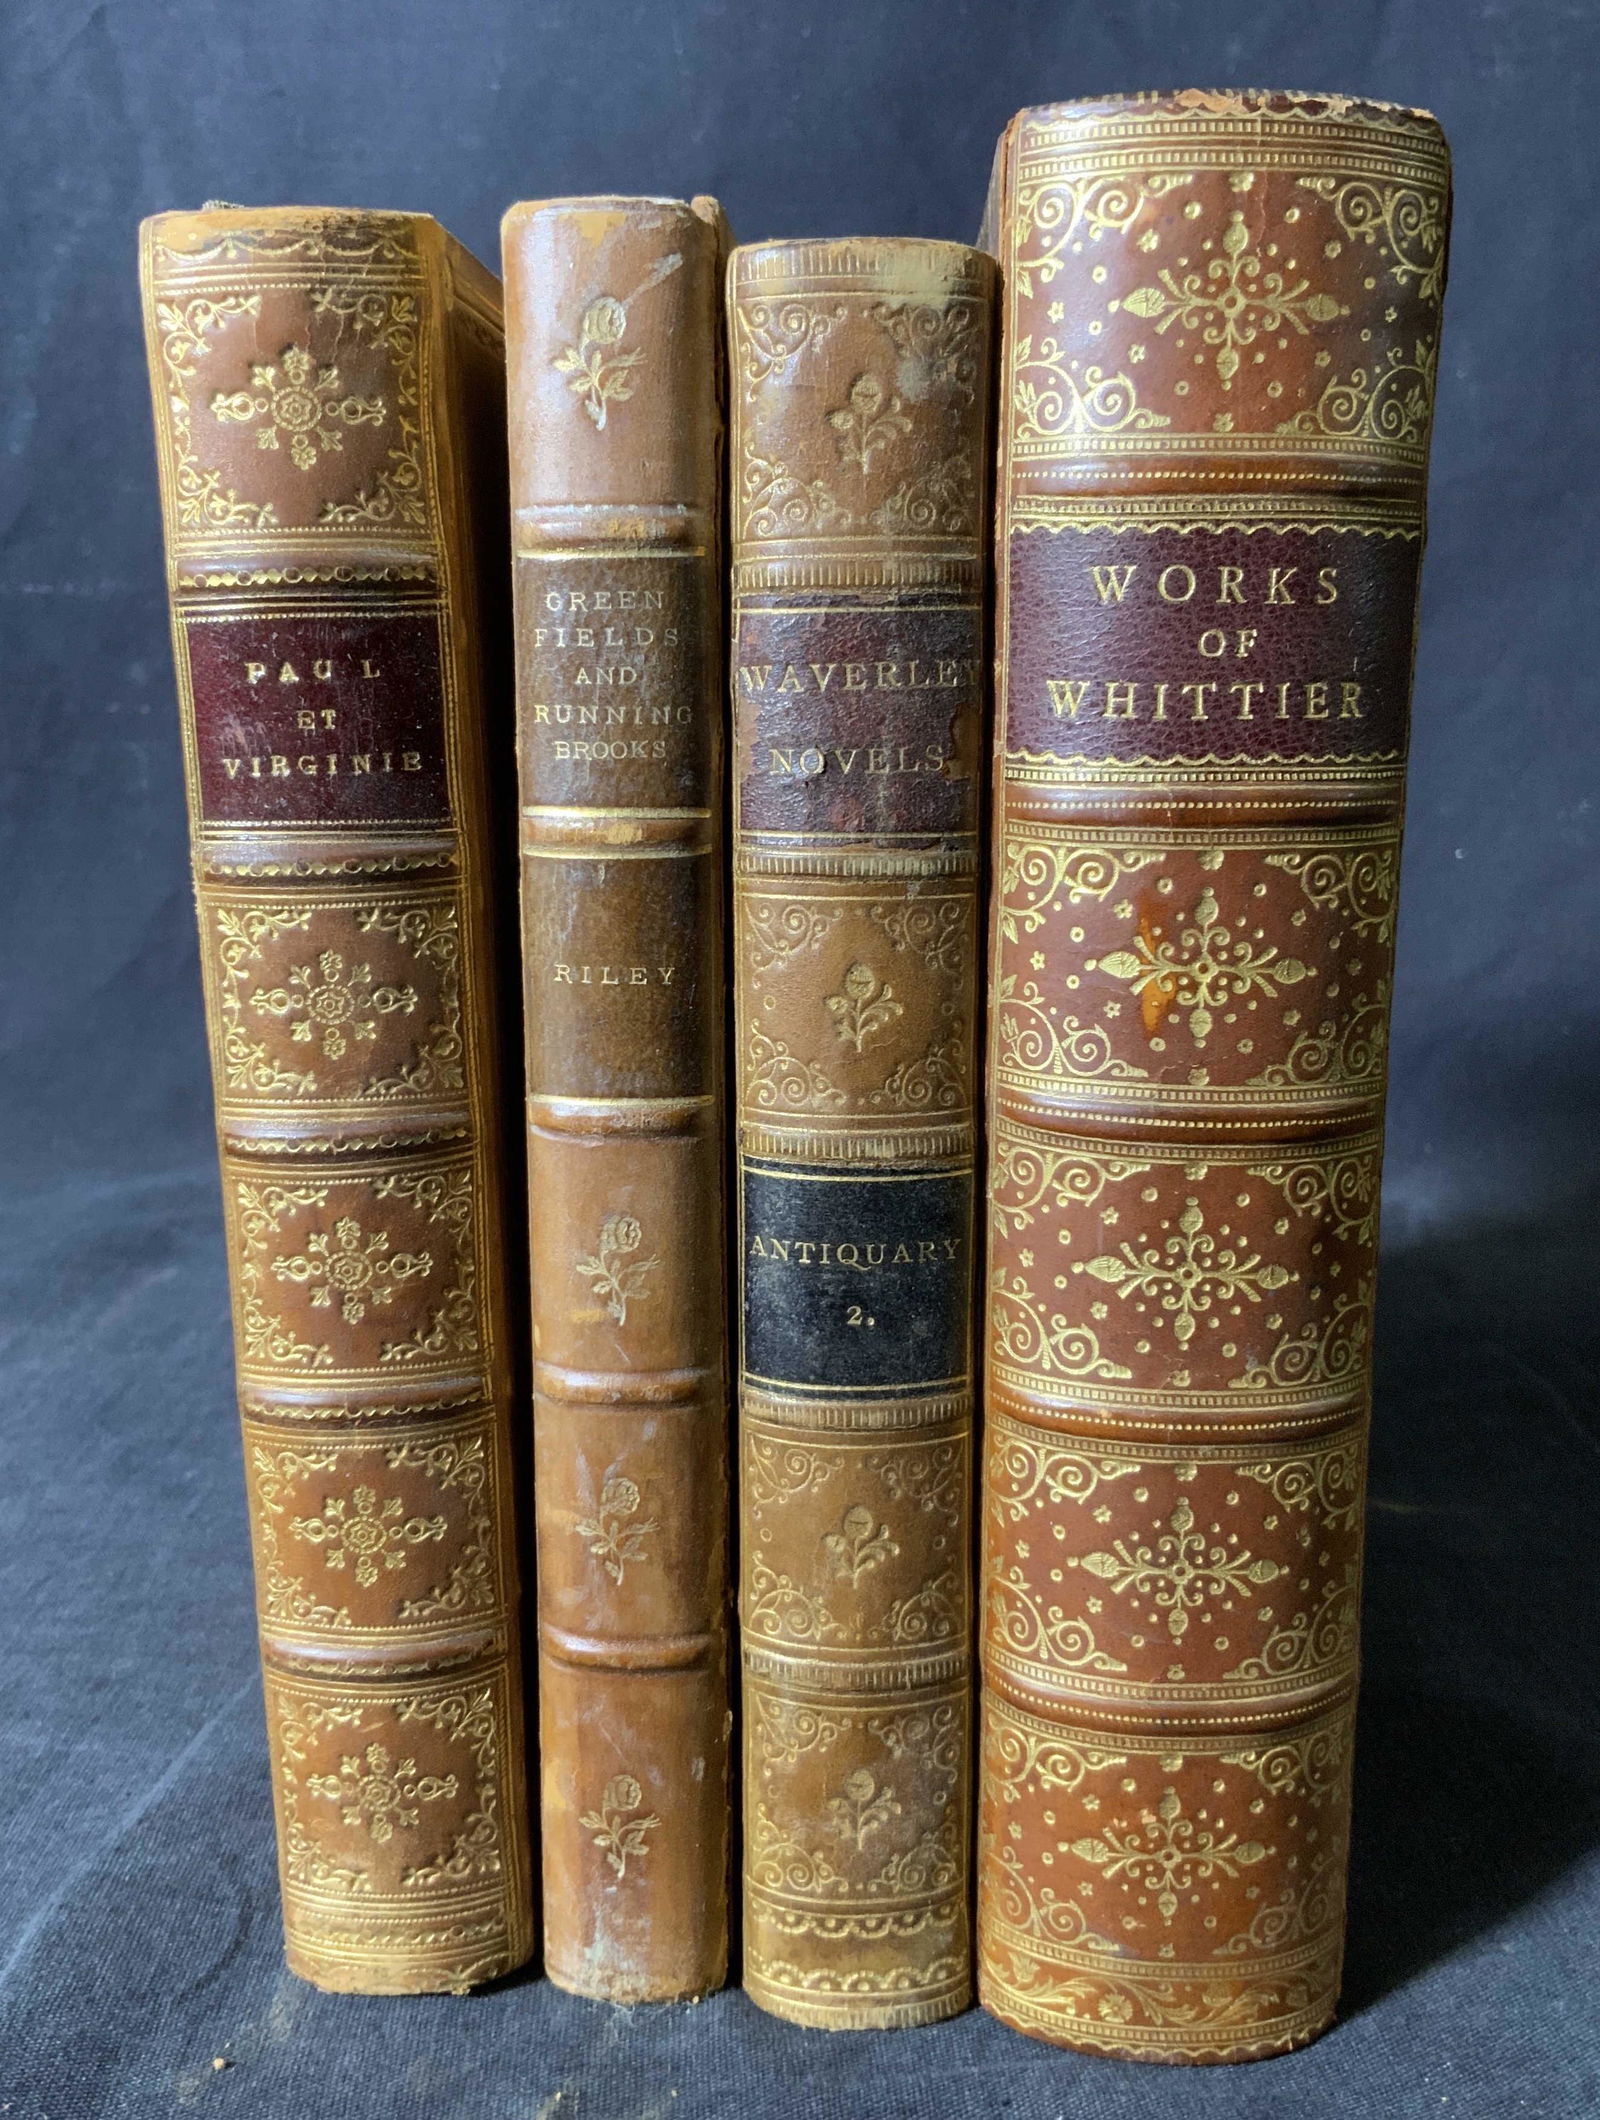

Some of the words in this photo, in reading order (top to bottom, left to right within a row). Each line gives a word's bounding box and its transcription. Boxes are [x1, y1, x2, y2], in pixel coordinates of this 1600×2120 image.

[1089, 564, 1339, 604] WORKS
[545, 590, 664, 612] GREEN
[534, 626, 679, 648] FIELDS
[1200, 628, 1258, 658] OF
[244, 658, 380, 684] PAUL
[575, 666, 637, 685] AND
[739, 659, 980, 694] WAVERLEY
[1046, 679, 1366, 720] WHITTIER
[297, 709, 337, 730] ET
[534, 704, 693, 725] RUNNING
[553, 740, 667, 761] BROOKS
[769, 744, 944, 775] NOVELS
[223, 752, 422, 779] VIRGINIE
[553, 963, 675, 985] RILEY
[750, 1235, 961, 1271] ANTIQUARY
[846, 1305, 875, 1326] 2.
